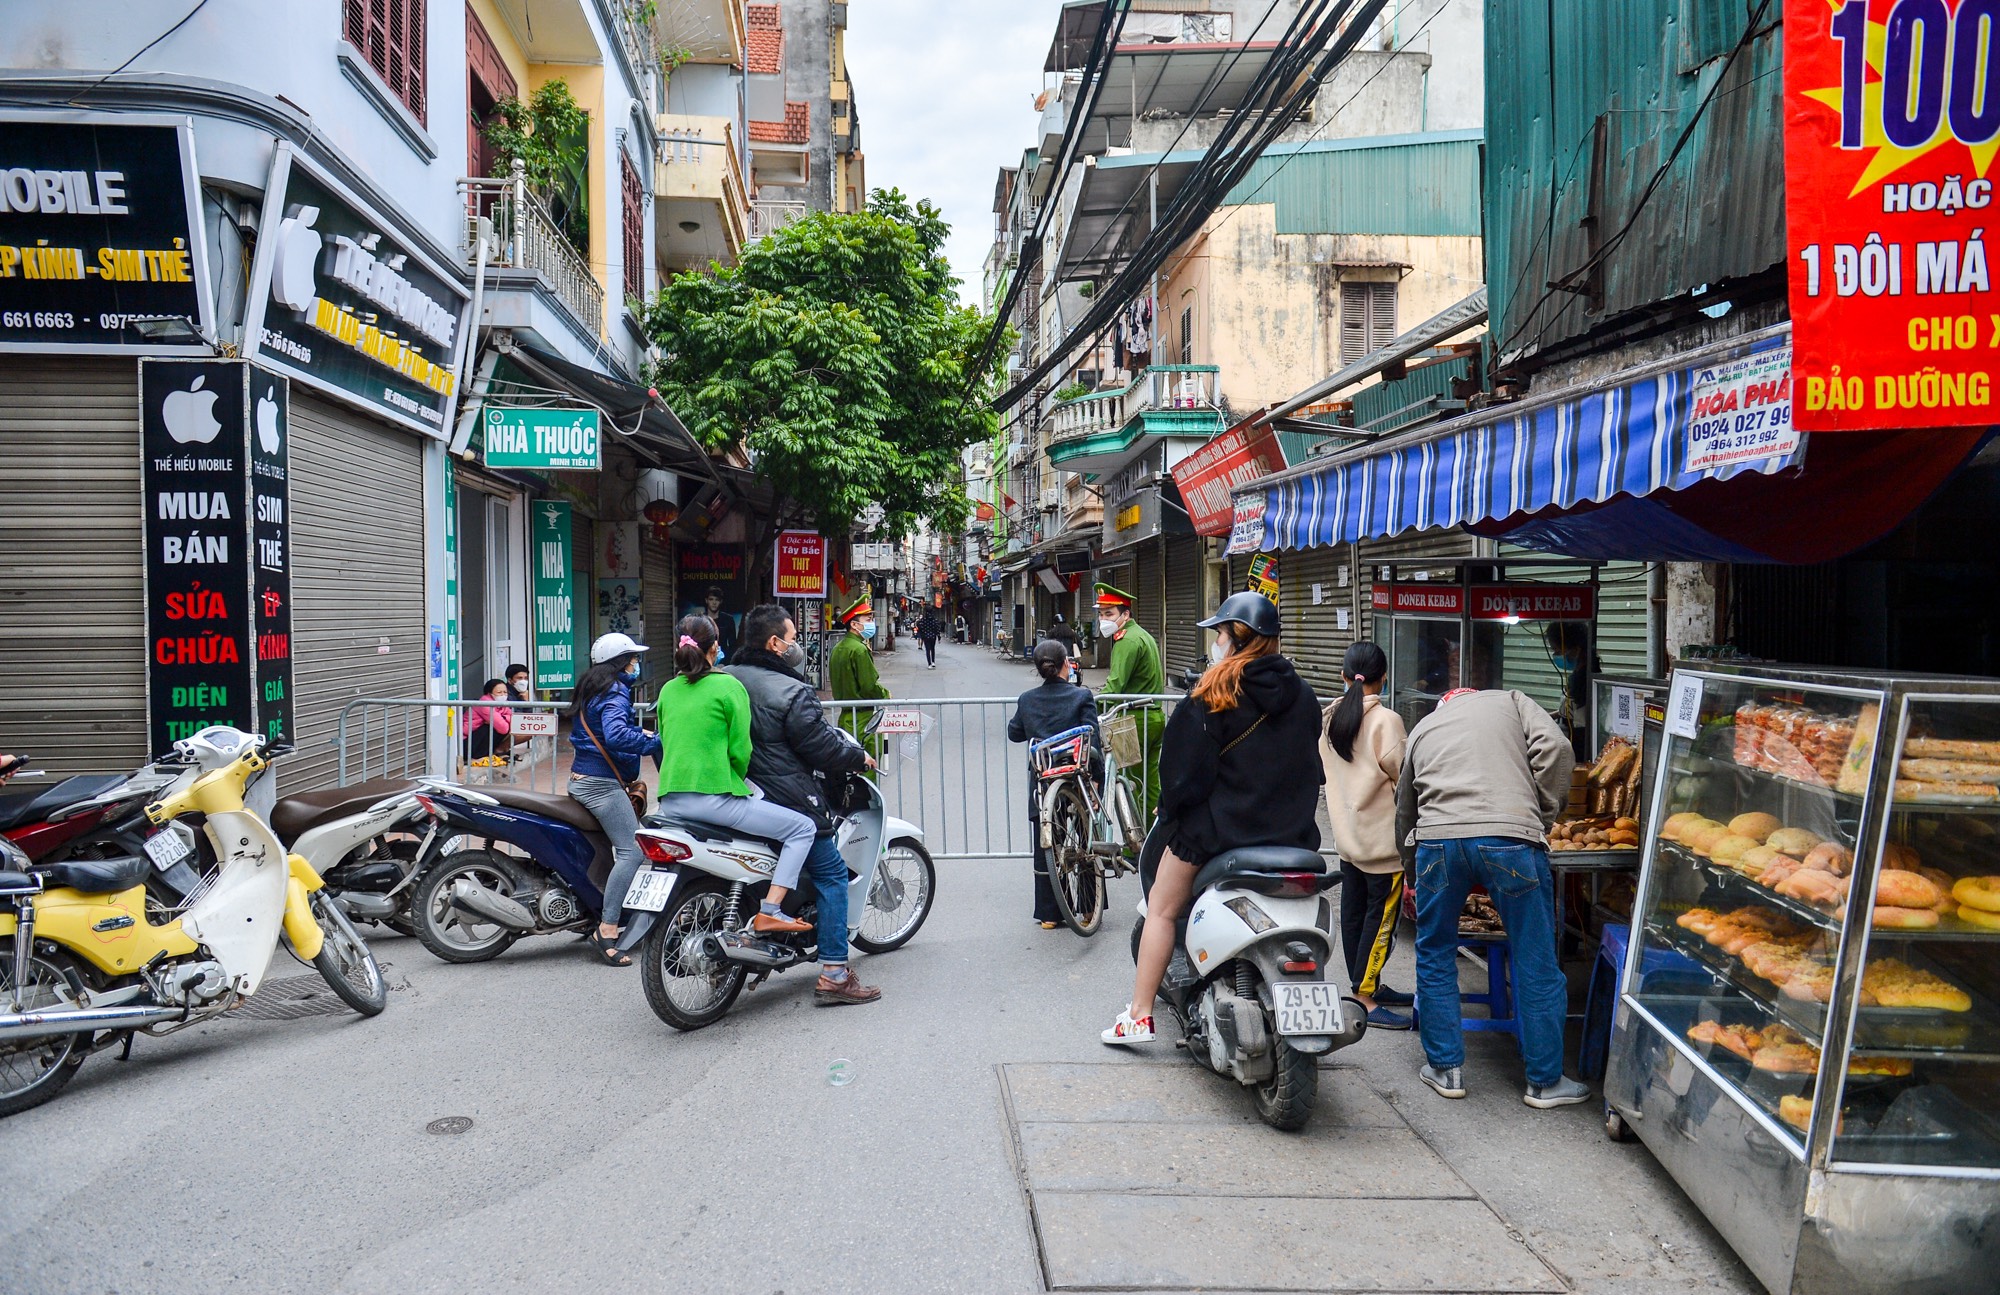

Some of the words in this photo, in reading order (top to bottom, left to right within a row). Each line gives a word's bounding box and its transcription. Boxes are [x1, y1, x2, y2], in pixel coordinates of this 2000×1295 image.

[1883, 175, 1992, 215] HOẶC
[0, 246, 20, 277] P
[21, 239, 85, 280] KÍNH
[98, 247, 147, 281] SIM
[145, 237, 192, 282] THẺ
[1801, 244, 1820, 296] 1
[1833, 233, 1901, 297] ĐÔI
[1916, 228, 1990, 295] MÁ
[3, 312, 32, 328] 661
[34, 312, 75, 329] 6663
[1908, 315, 1977, 351] CHO
[1806, 365, 1864, 411] BẢO
[1875, 367, 1990, 410] DƯỠNG
[1692, 387, 1738, 420] HÒA
[488, 419, 528, 453] NHÀ
[533, 416, 596, 455] THUỐC
[1692, 418, 1729, 442] 0924
[1734, 410, 1766, 433] 027
[1735, 434, 1756, 447] 312
[1759, 429, 1779, 443] 992
[154, 454, 172, 471] THẾ
[174, 454, 196, 471] HIẾU
[198, 459, 233, 471] MOBILE
[550, 457, 570, 466] MINH
[571, 456, 587, 466] TIẾN
[159, 492, 231, 520] MUA
[257, 494, 282, 524] SIM
[163, 530, 229, 564] BÁN
[259, 530, 282, 567] THẺ
[541, 533, 565, 579] NHÀ
[782, 545, 799, 555] Tây
[711, 551, 742, 579] Shop
[792, 557, 810, 573] THỊT
[781, 575, 798, 589] HUN
[800, 574, 820, 590] KHÓI
[166, 581, 228, 620] SỬA
[264, 586, 280, 618] ÉP
[537, 582, 571, 634] THUỐC
[1398, 592, 1427, 607] DÖNER
[1428, 595, 1457, 608] KEBAB
[1535, 596, 1581, 612] KEBAB
[156, 630, 239, 665] CHỮA
[259, 629, 288, 661] KÍNH
[538, 645, 553, 662] MINH
[172, 682, 227, 712] ĐIỆN
[265, 676, 284, 702] GIÁ
[520, 723, 547, 731] STOP
[354, 813, 392, 829] VISION
[471, 807, 517, 822] VISION
[149, 831, 177, 855] 29-L1
[848, 835, 869, 845] HONDA
[155, 842, 187, 869] 722.08
[1283, 986, 1332, 1008] 29-C1
[1281, 1009, 1340, 1031] 245.74
